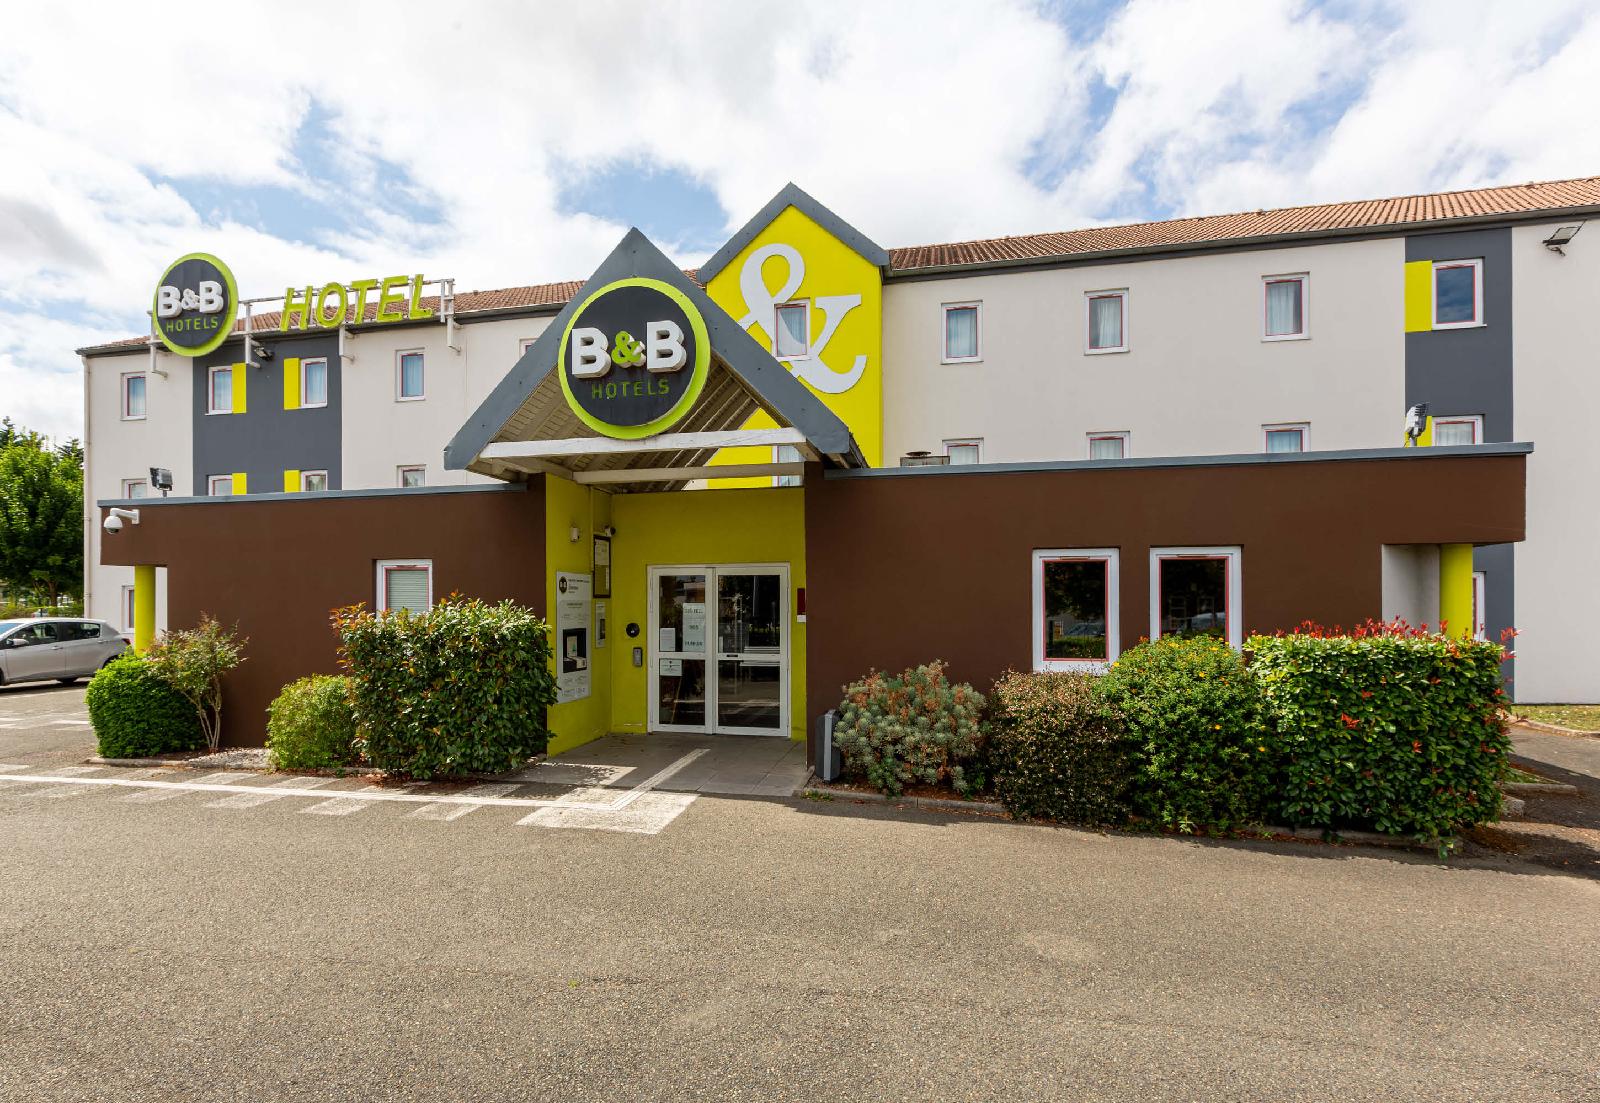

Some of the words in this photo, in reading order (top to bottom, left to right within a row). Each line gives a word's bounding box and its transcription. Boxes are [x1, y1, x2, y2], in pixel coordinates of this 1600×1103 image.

[157, 280, 224, 318] B&B
[280, 273, 435, 332] HOTEL
[166, 316, 219, 333] HOTELS
[571, 320, 687, 379] B&B
[591, 379, 670, 400] HOTELS
